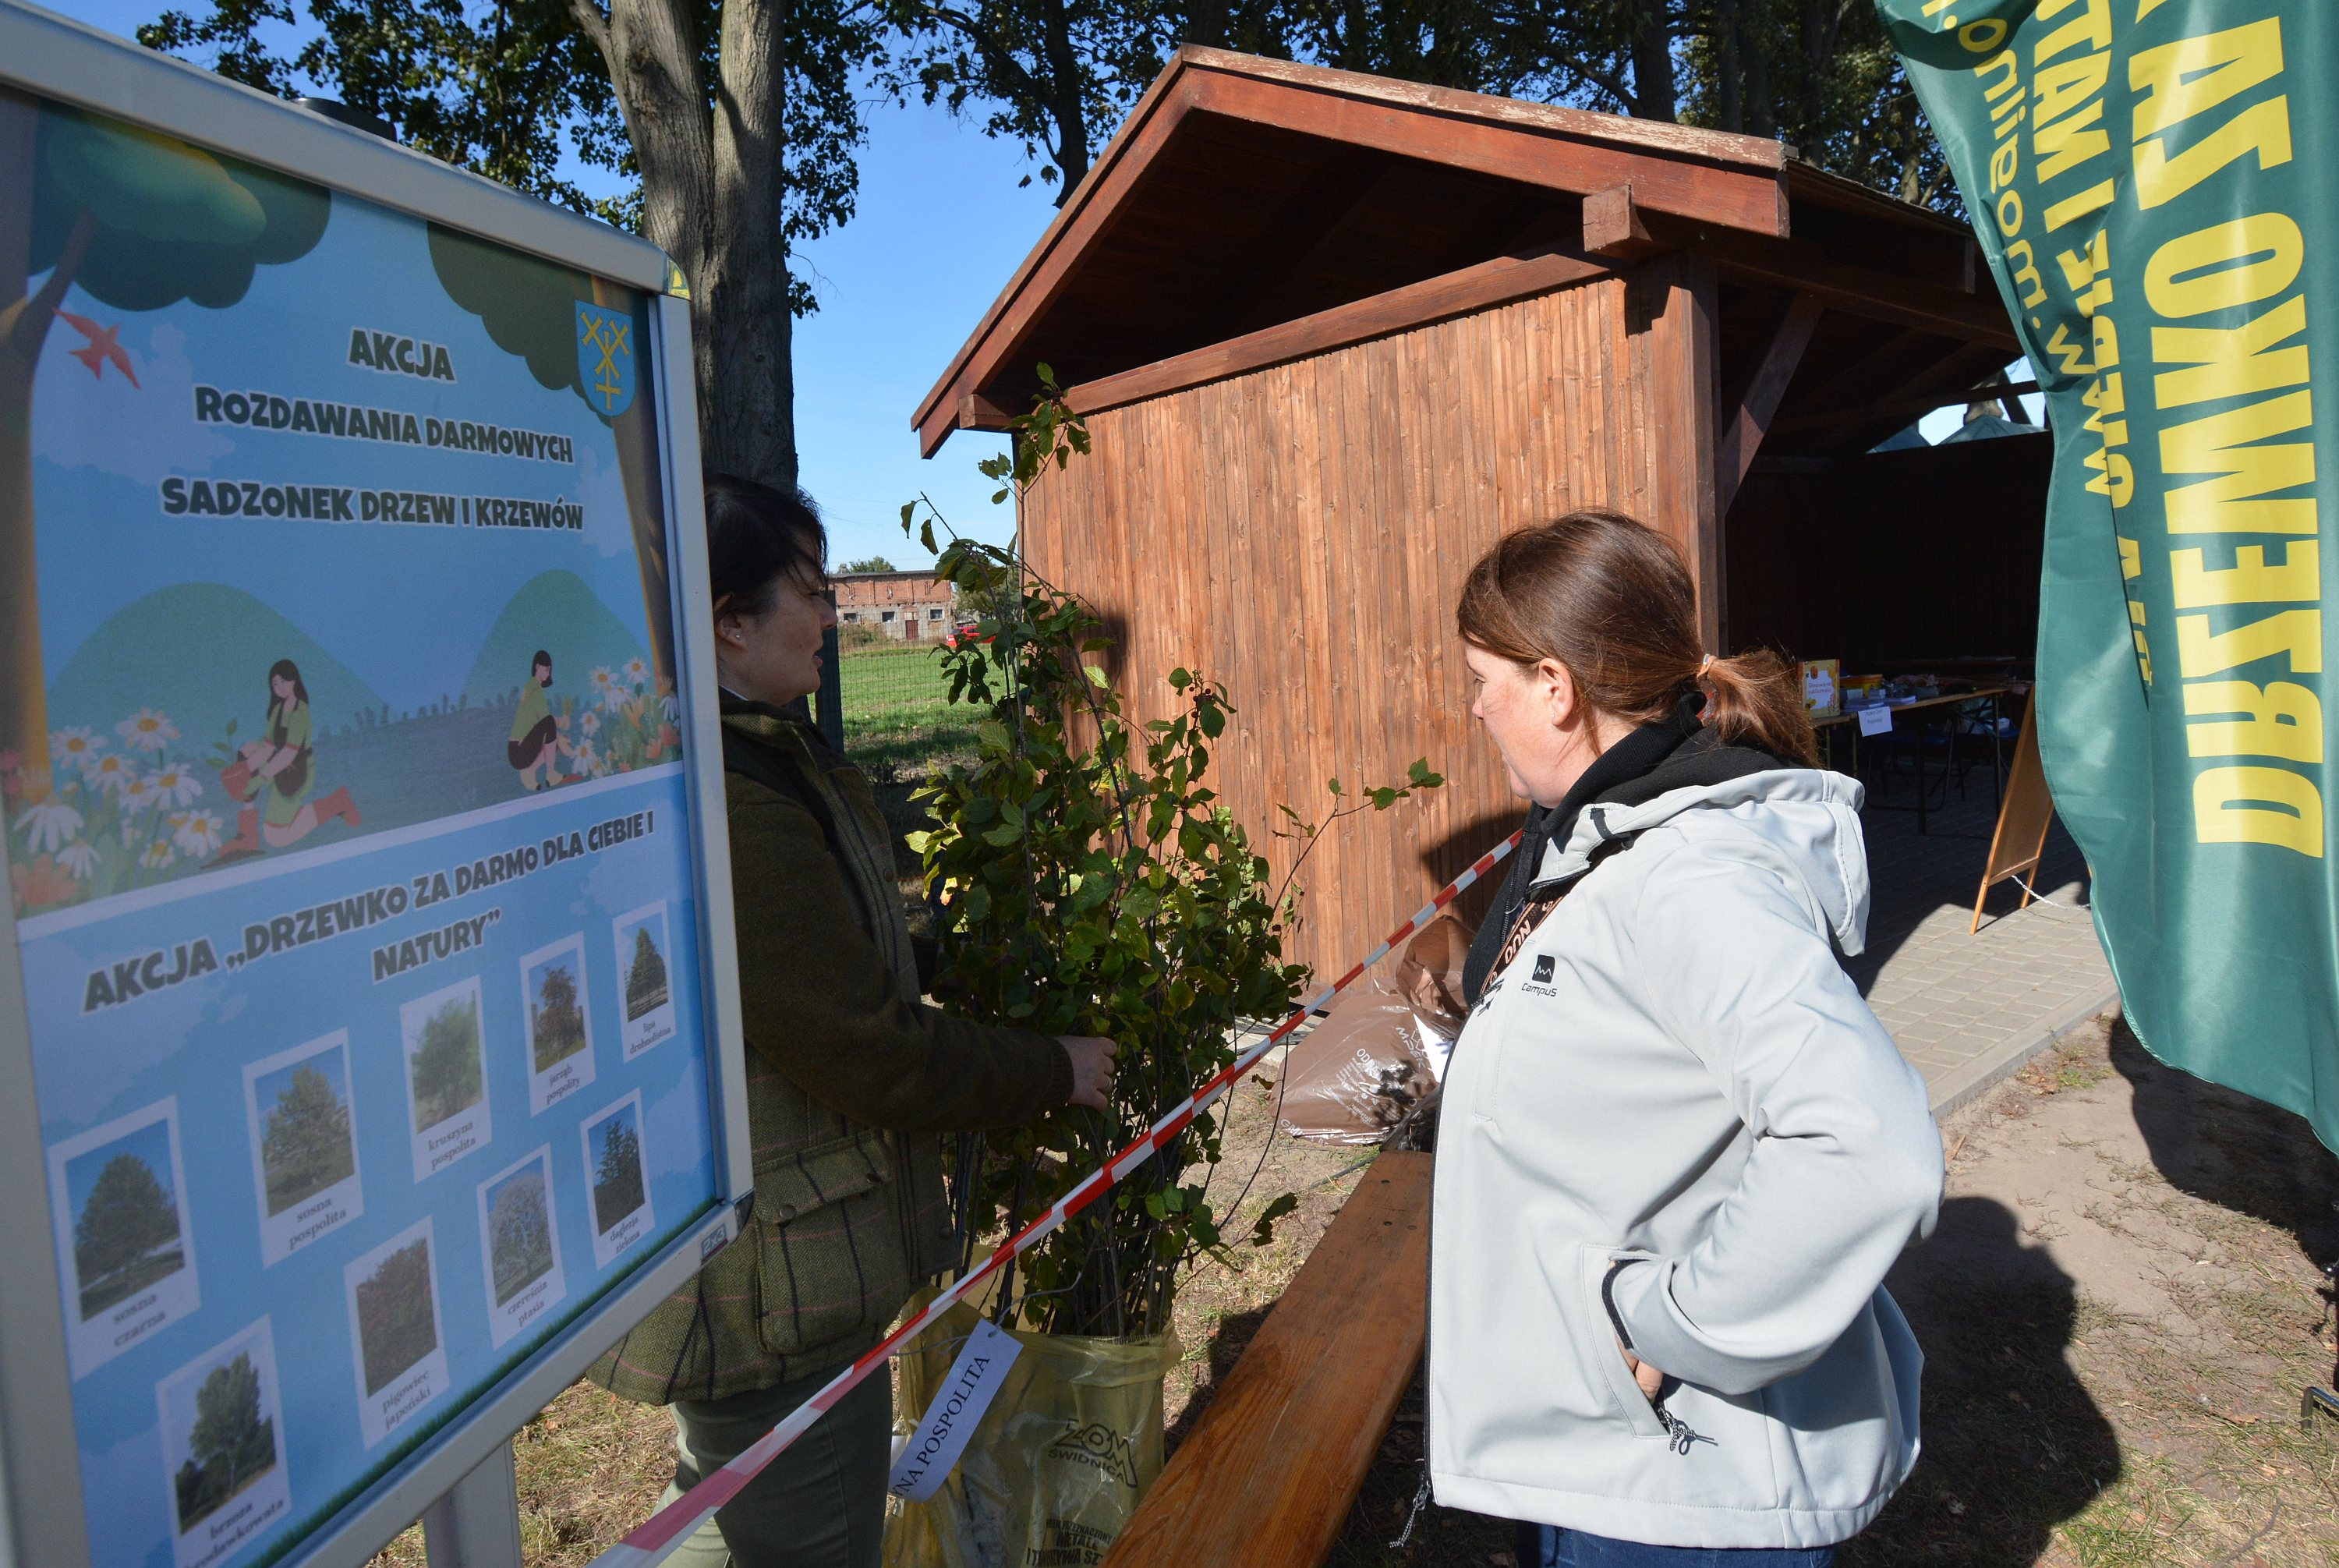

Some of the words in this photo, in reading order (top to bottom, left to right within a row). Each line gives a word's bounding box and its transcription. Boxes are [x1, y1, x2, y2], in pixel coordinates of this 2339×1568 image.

[348, 328, 456, 382] AKCJA
[195, 387, 421, 444] ROZDAWANIA
[426, 419, 575, 464] DARMOWYCH
[161, 476, 354, 522] SADZONEK
[359, 490, 456, 526] DRZEW
[462, 498, 471, 525] I
[476, 494, 584, 531] KRZEWÓW
[83, 940, 218, 1013] AKCJA
[412, 872, 453, 909] ZA
[455, 846, 540, 899] DARMO
[543, 832, 585, 869] DLA
[587, 816, 644, 854] CIEBIE
[646, 810, 655, 834] I
[629, 1027, 671, 1054] drobnolistna
[643, 1021, 656, 1033] lipa
[547, 1078, 580, 1105] pospolity
[429, 1121, 473, 1152] kruszyna
[431, 1138, 476, 1171] pospolita
[297, 1198, 332, 1222] sosna
[289, 1209, 347, 1251] pospolita
[113, 1294, 157, 1322] sosna
[518, 1300, 544, 1327] ptasia
[114, 1311, 167, 1347] czarna
[385, 1385, 431, 1432] japoński
[915, 1354, 991, 1467] POSPOLITA
